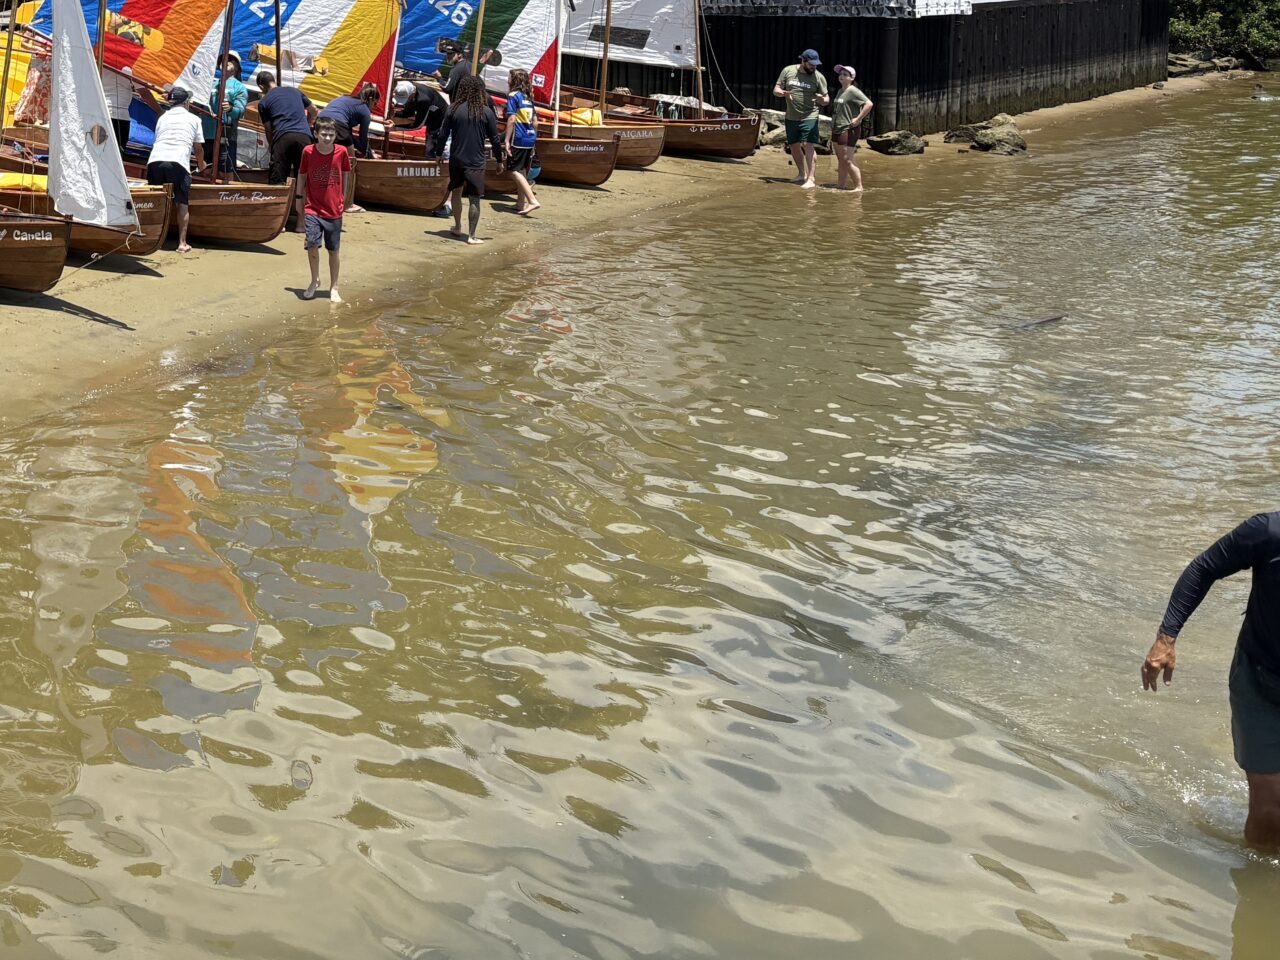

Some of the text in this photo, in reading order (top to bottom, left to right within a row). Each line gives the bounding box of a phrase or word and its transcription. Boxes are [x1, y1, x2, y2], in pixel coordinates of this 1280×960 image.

[563, 143, 604, 153] Quintino's
[218, 191, 276, 202] Turtle Run
[12, 229, 53, 241] Canela
